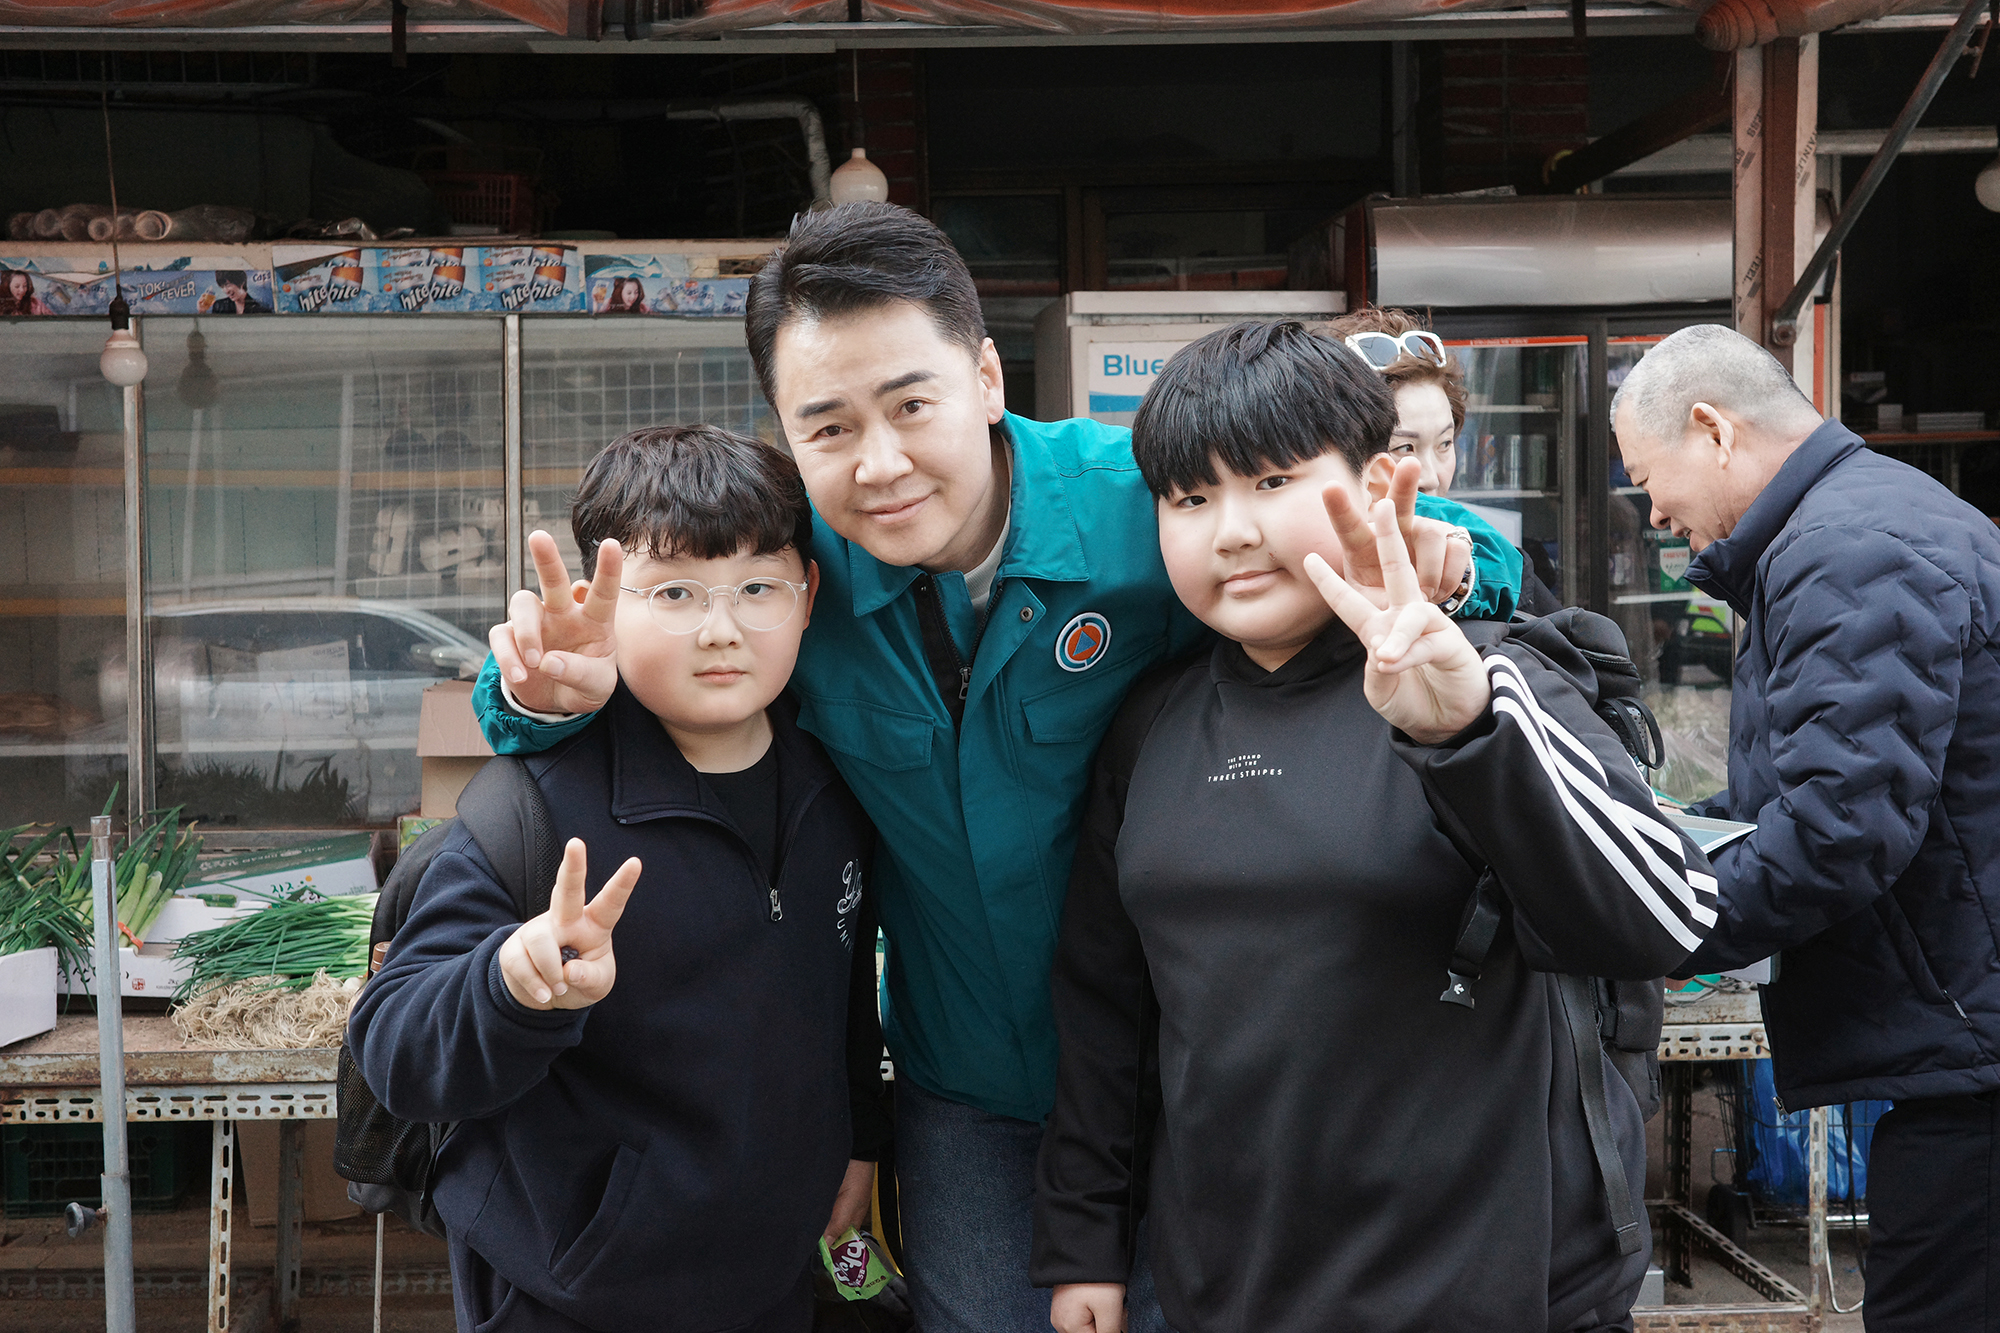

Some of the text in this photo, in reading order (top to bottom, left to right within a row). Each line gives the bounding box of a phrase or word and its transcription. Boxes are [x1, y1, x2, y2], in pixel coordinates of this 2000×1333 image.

[161, 281, 196, 300] FEVER
[299, 284, 328, 312] hite
[400, 284, 430, 311] hite
[501, 283, 531, 310] hite
[1104, 354, 1164, 376] Blue
[1208, 769, 1283, 782] THREE STRIPES
